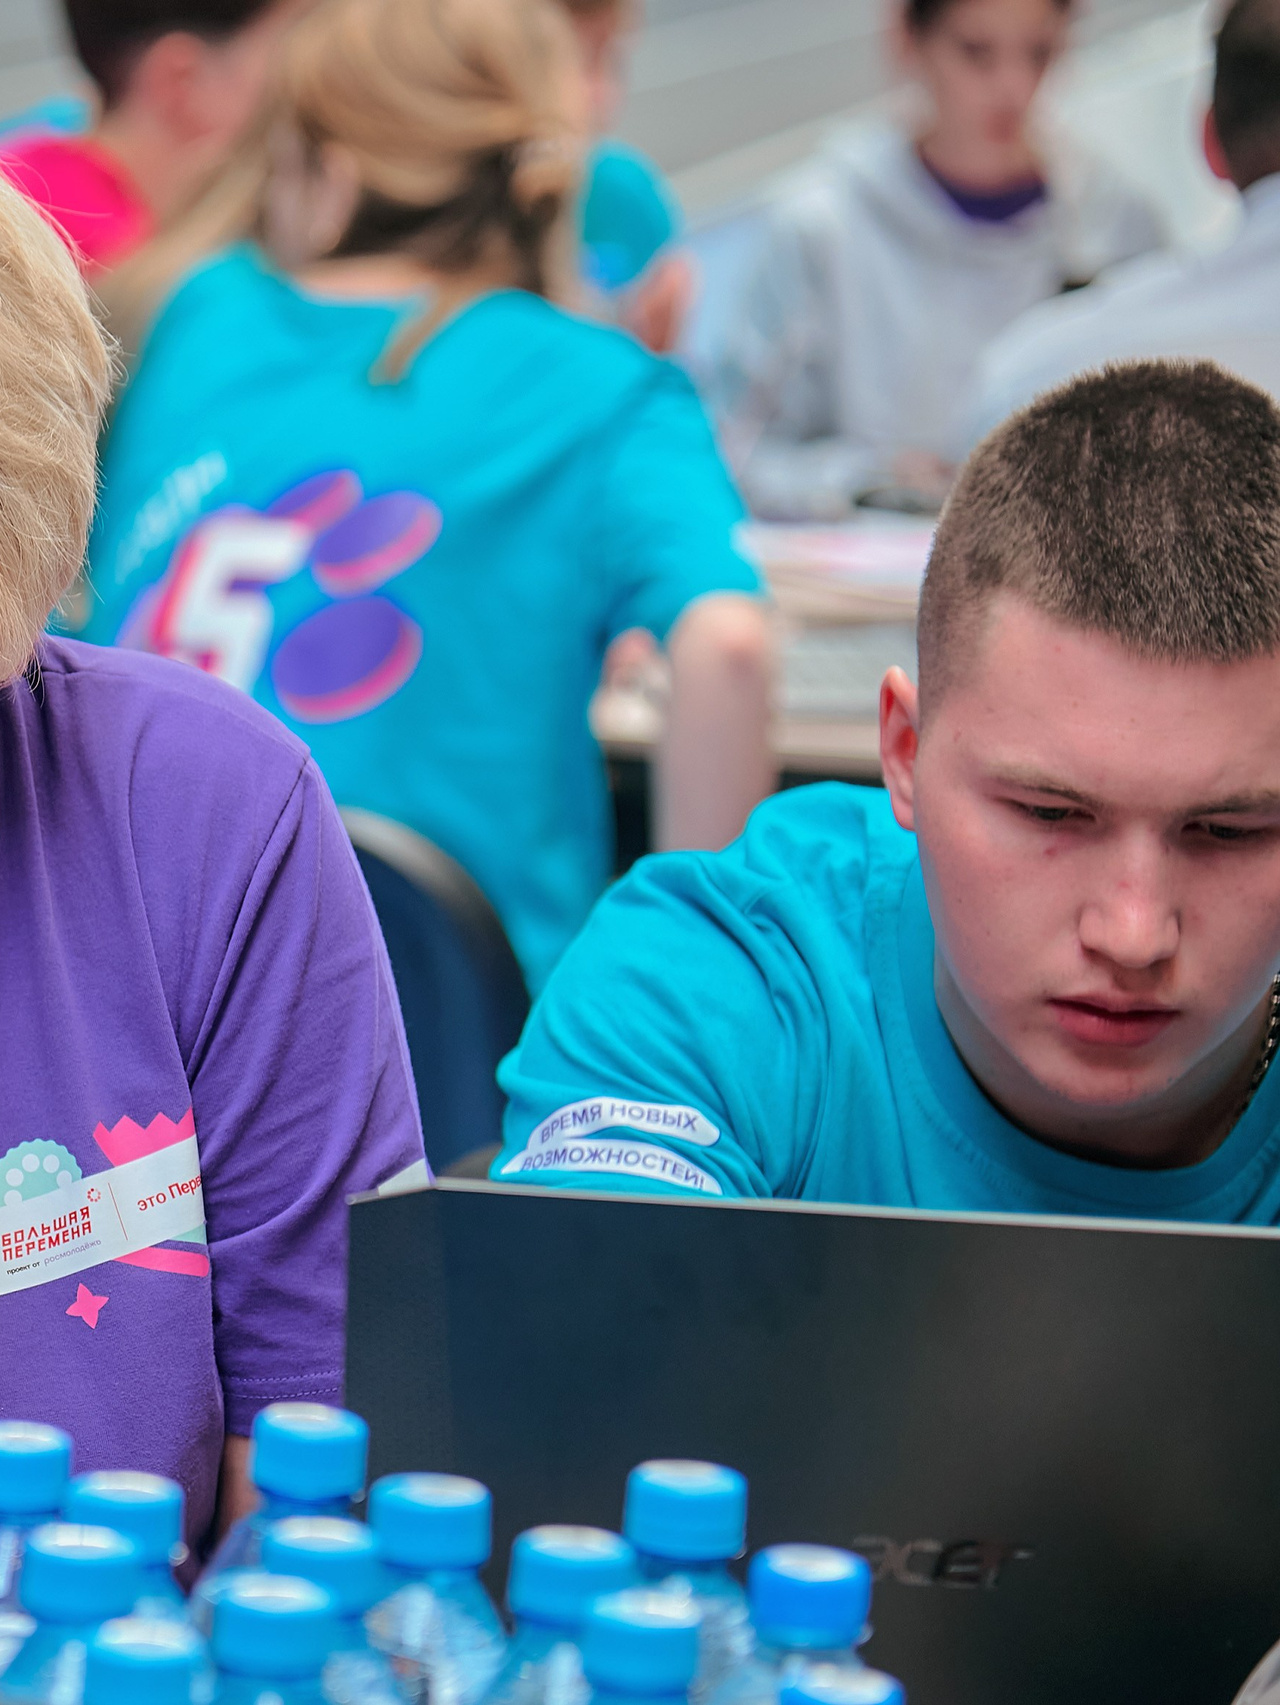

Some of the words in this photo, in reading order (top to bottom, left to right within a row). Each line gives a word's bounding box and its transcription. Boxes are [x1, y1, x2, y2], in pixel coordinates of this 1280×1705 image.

[541, 1104, 602, 1144] ВРЕМЯ
[610, 1103, 701, 1132] НОВЫХ
[521, 1148, 705, 1190] ВОЗМОЖНОСТЕЙ!
[137, 1192, 167, 1211] это
[1, 1206, 90, 1247] БОЛЬШАЯ
[2, 1221, 92, 1262] ПЕРЕМЕНА
[6, 1264, 31, 1275] проект
[43, 1239, 102, 1267] росмолодёжь
